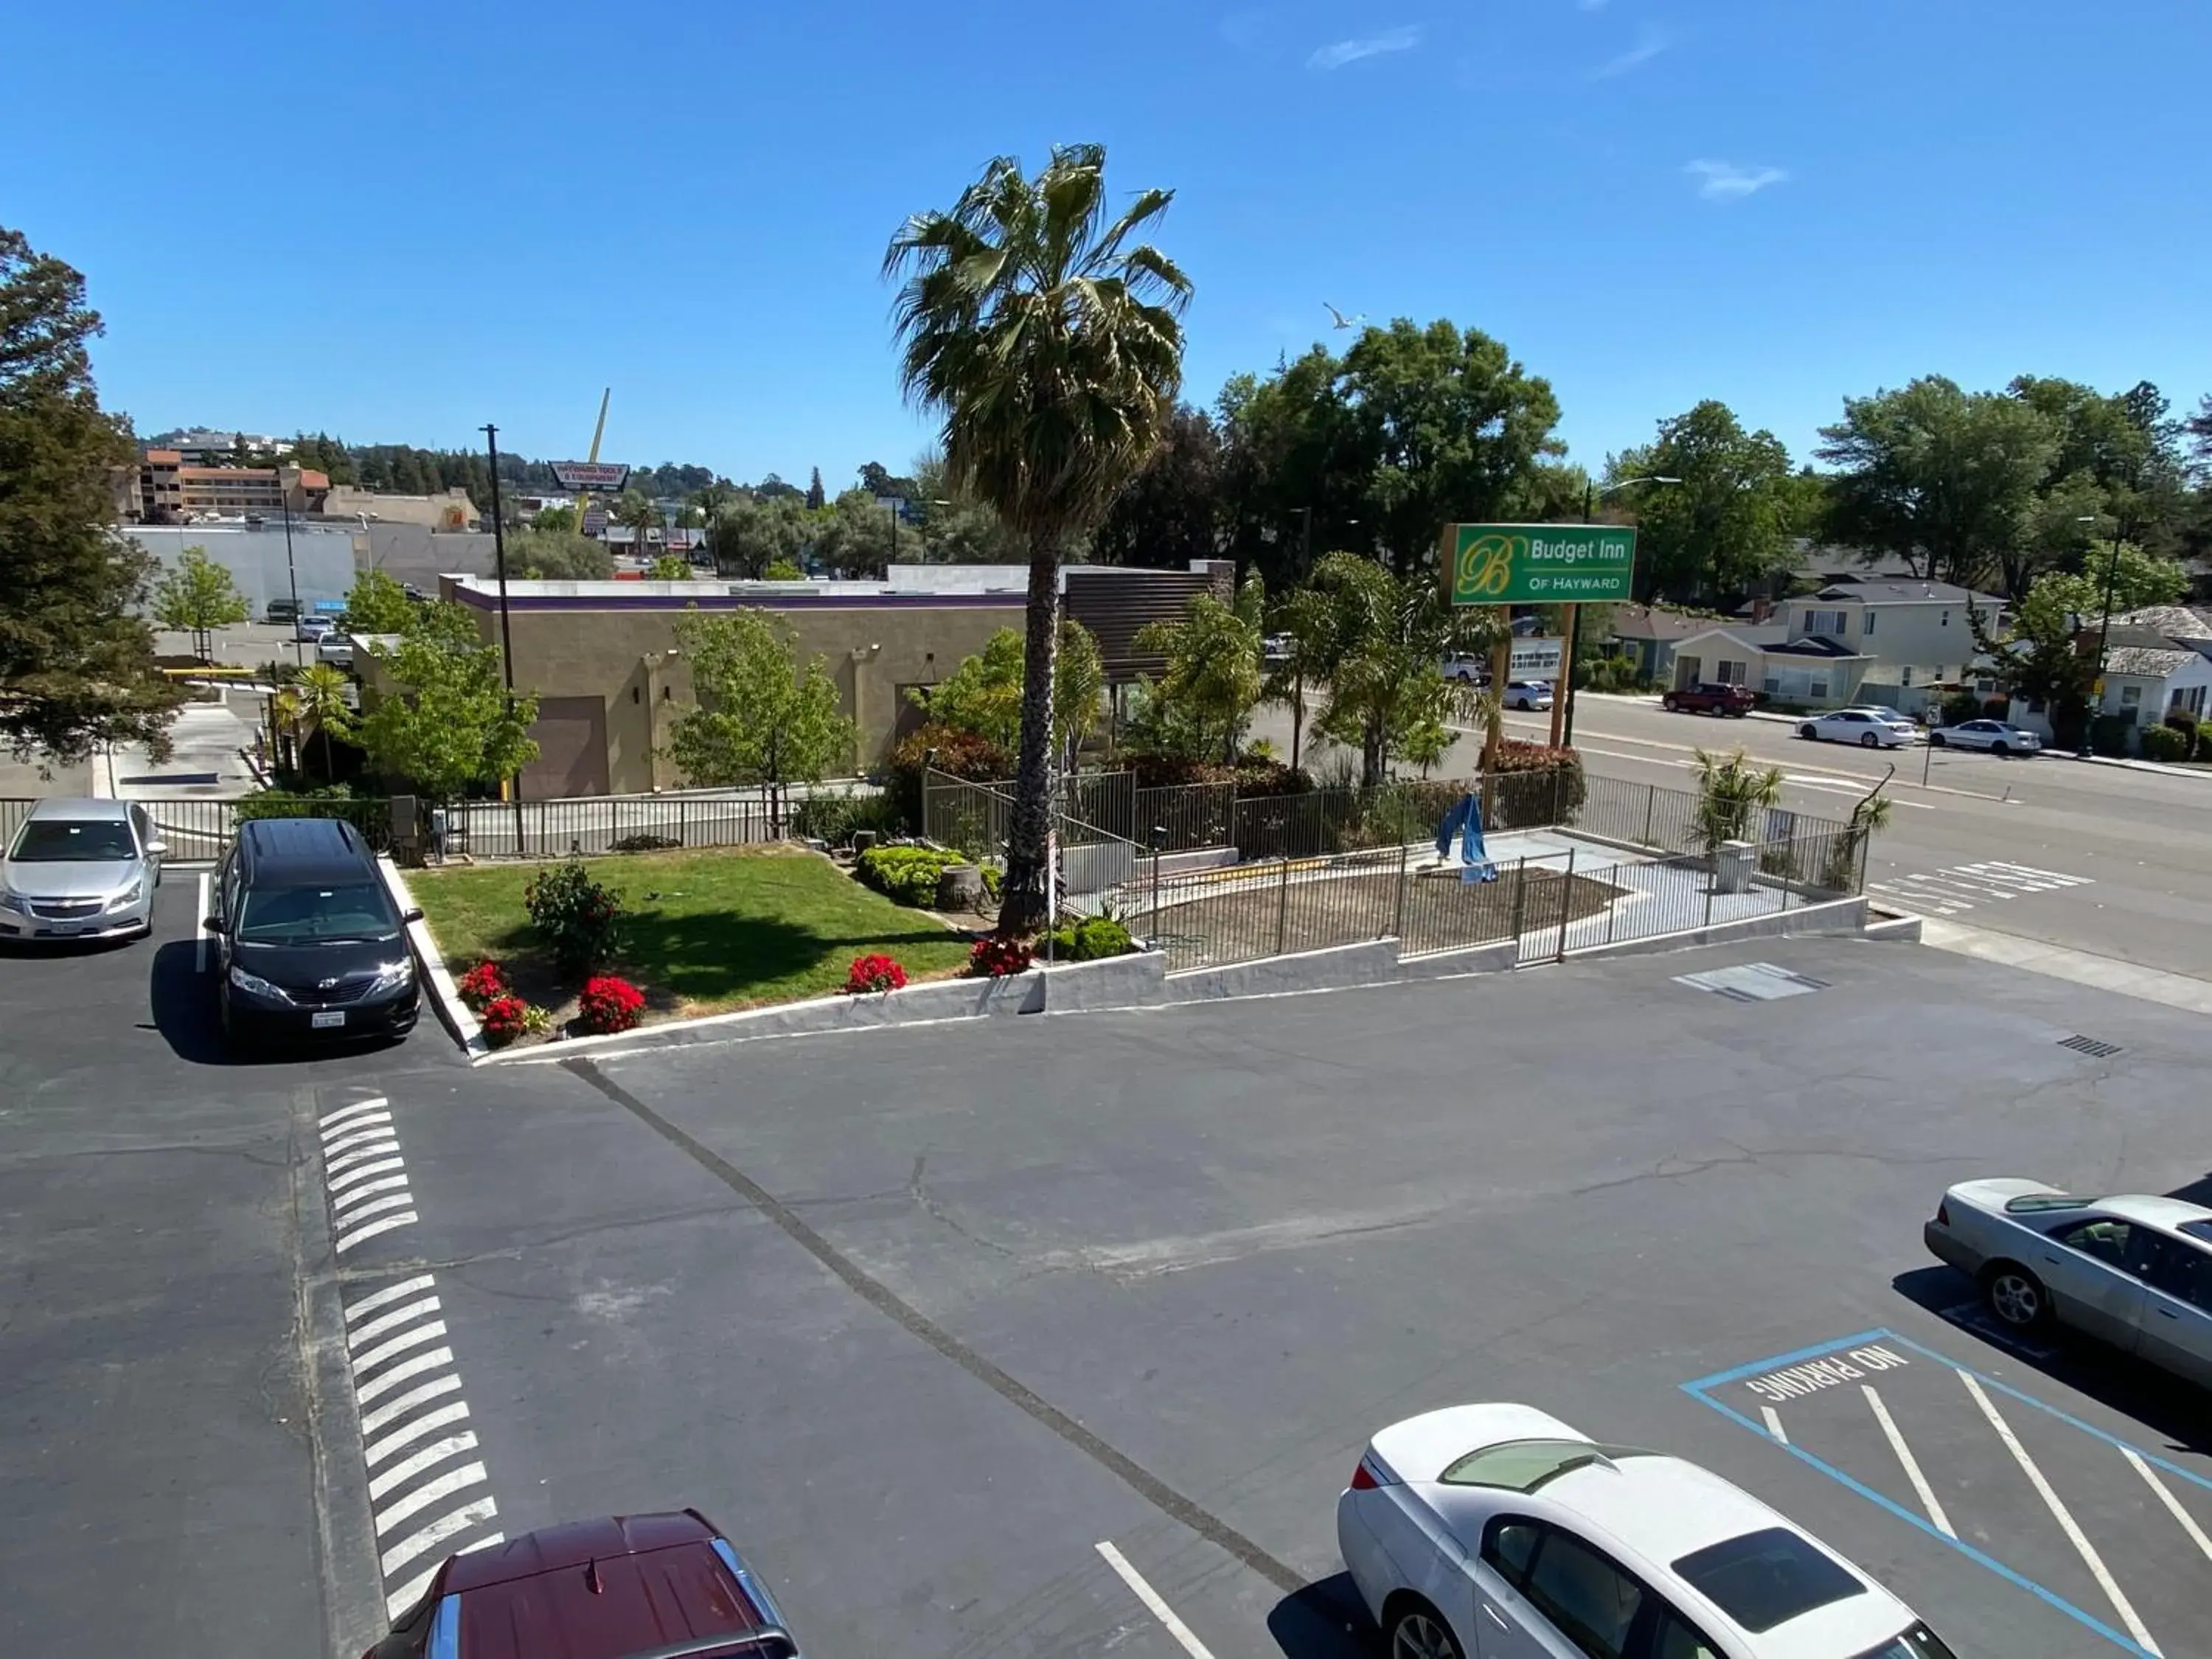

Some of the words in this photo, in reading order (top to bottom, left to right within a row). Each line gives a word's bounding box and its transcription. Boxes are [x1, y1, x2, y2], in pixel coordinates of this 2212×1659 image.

[1531, 539, 1593, 563] Budget
[1599, 539, 1625, 559] Inn
[1528, 578, 1549, 591] OF
[1552, 577, 1621, 590] HAYWARD
[1848, 1345, 1910, 1371] NO
[1745, 1357, 1865, 1402] PARKING
